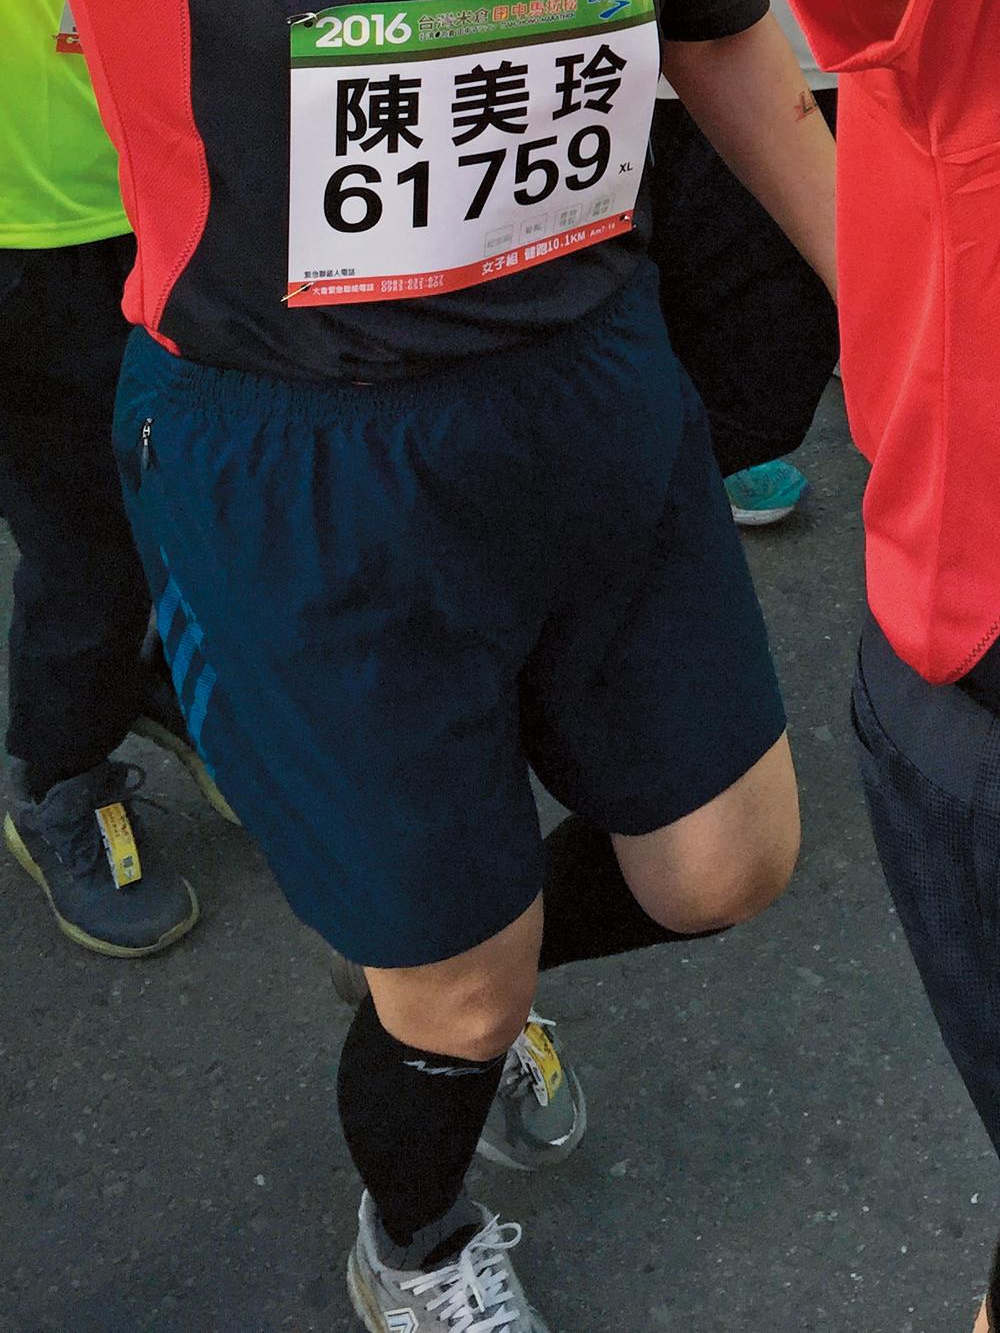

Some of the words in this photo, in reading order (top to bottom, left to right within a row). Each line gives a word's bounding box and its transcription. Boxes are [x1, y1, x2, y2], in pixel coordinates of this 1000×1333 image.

[315, 13, 412, 47] 2016
[334, 43, 628, 157] 陳美玲
[323, 124, 612, 233] 61759
[619, 163, 633, 174] XL
[482, 251, 518, 275] 女子組
